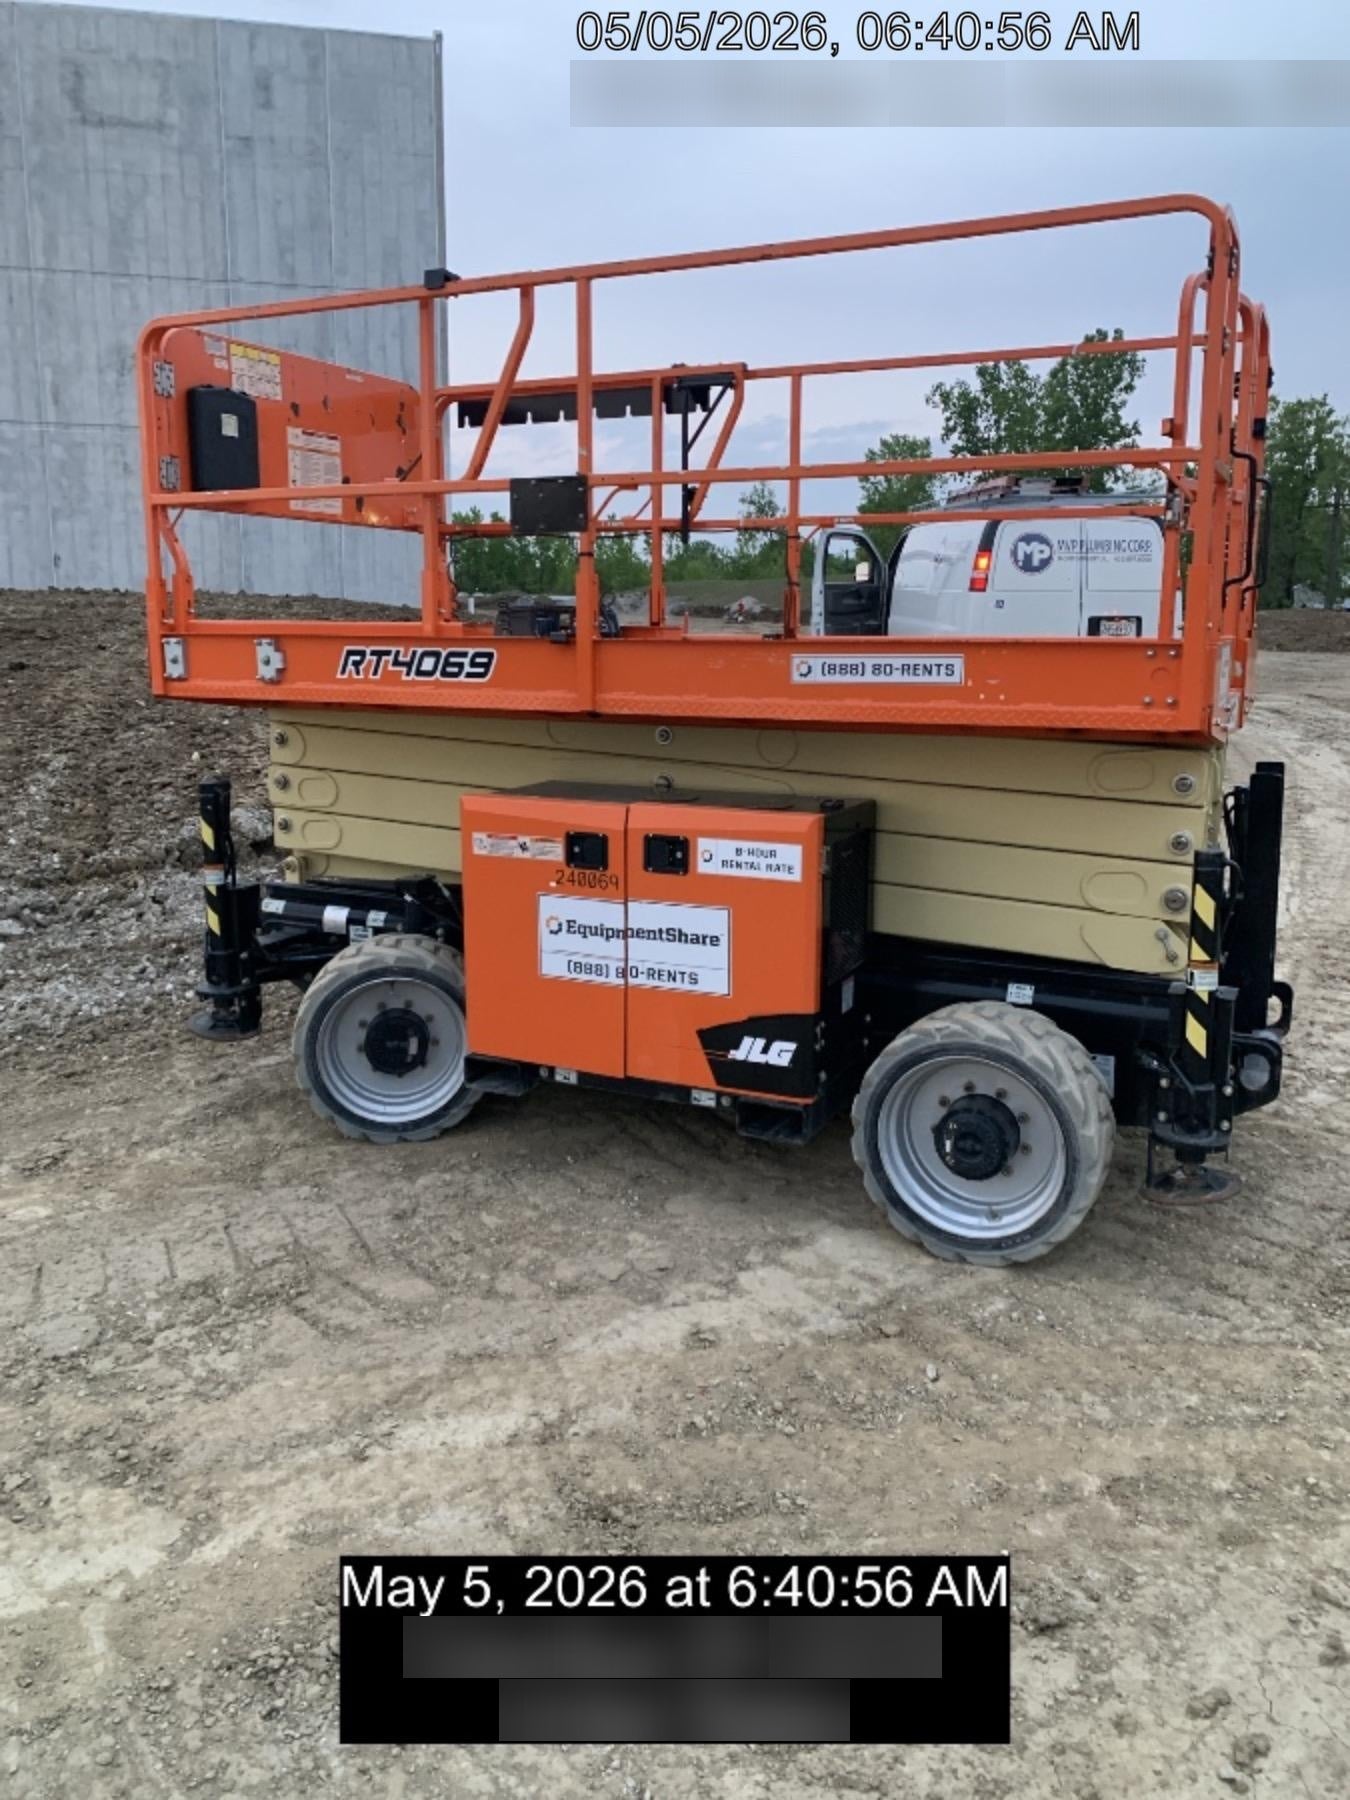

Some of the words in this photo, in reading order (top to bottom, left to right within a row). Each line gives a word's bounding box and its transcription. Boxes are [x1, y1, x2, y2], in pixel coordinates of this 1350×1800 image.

[338, 646, 496, 682] RT4069
[821, 661, 866, 677] (888)
[871, 662, 956, 678] 80-RENTS
[735, 847, 777, 859] 8-HOUR
[721, 859, 761, 871] RENTAL
[765, 863, 795, 875] RATE
[555, 869, 620, 890] 240069
[565, 919, 721, 946] EquipmentShare
[567, 959, 610, 979] (888)
[615, 965, 700, 986] 80-RENTS
[728, 1035, 798, 1067] JLG
